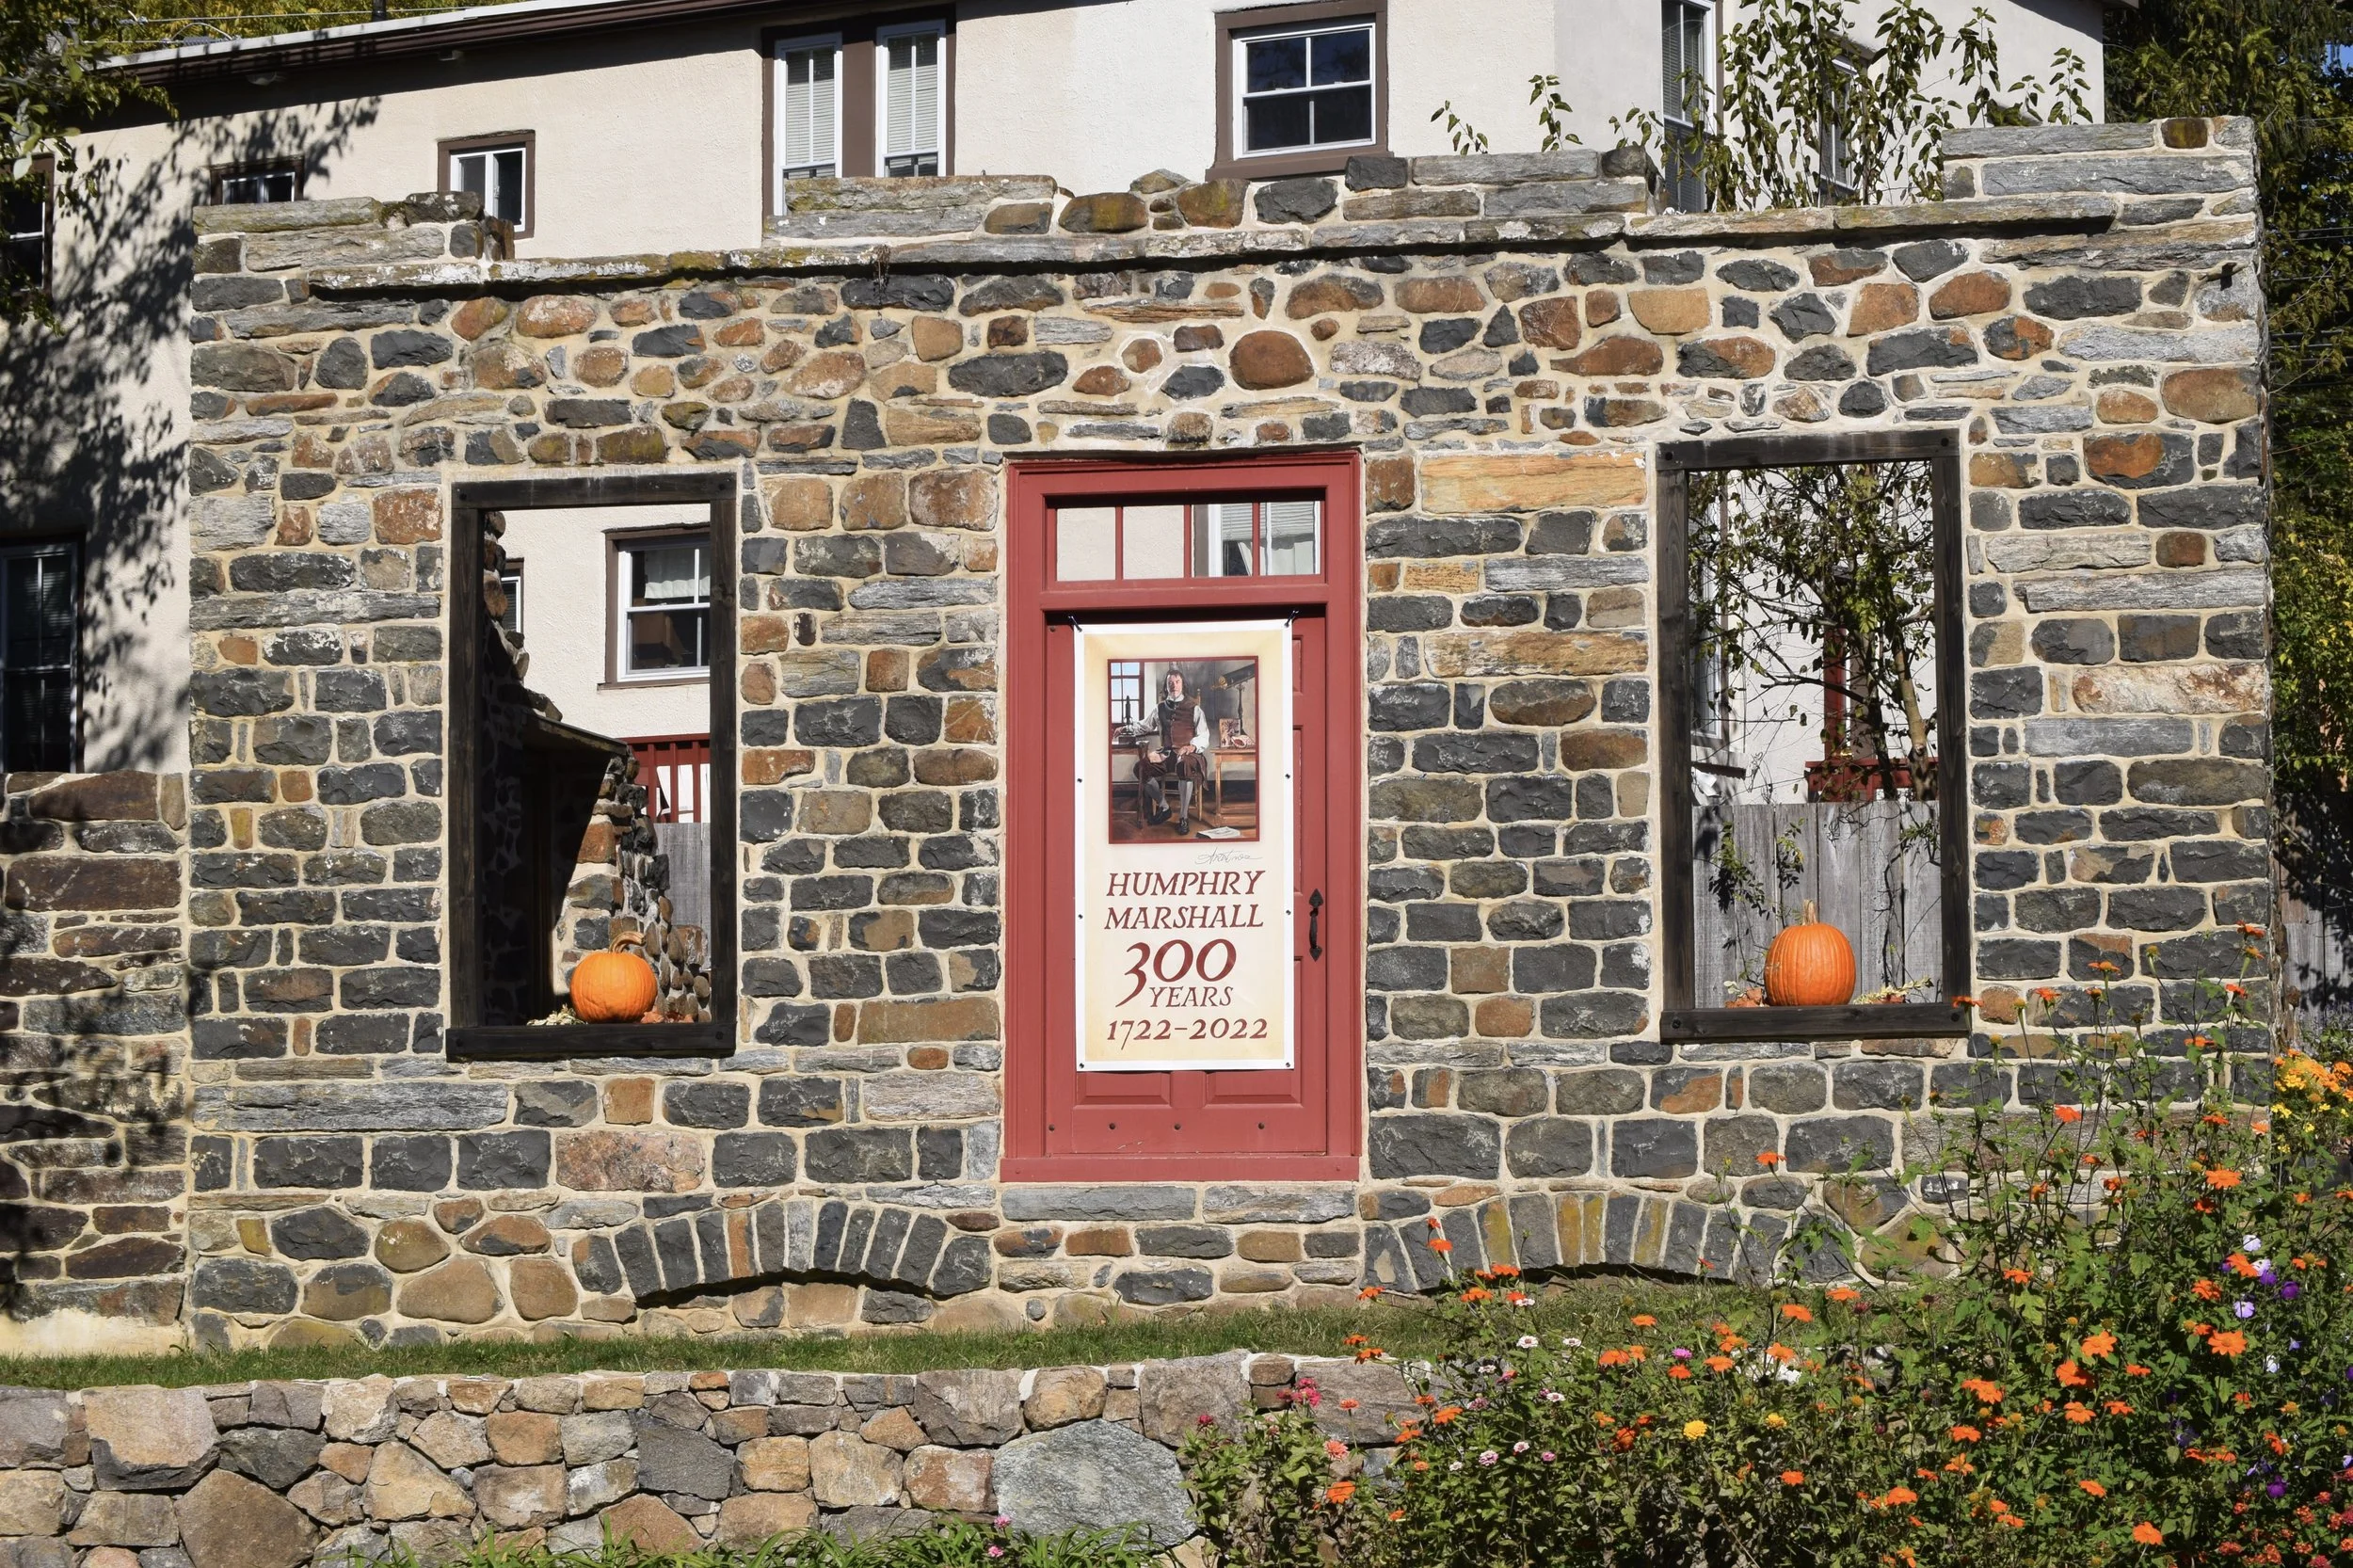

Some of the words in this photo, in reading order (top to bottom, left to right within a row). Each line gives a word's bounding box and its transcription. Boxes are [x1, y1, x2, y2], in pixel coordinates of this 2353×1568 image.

[1106, 871, 1266, 896] HUMPHRY
[1104, 904, 1264, 929] MARSHALL
[1115, 938, 1237, 1007] 300
[1149, 986, 1233, 1007] YEARS
[1107, 1018, 1267, 1050] 1722-2022
